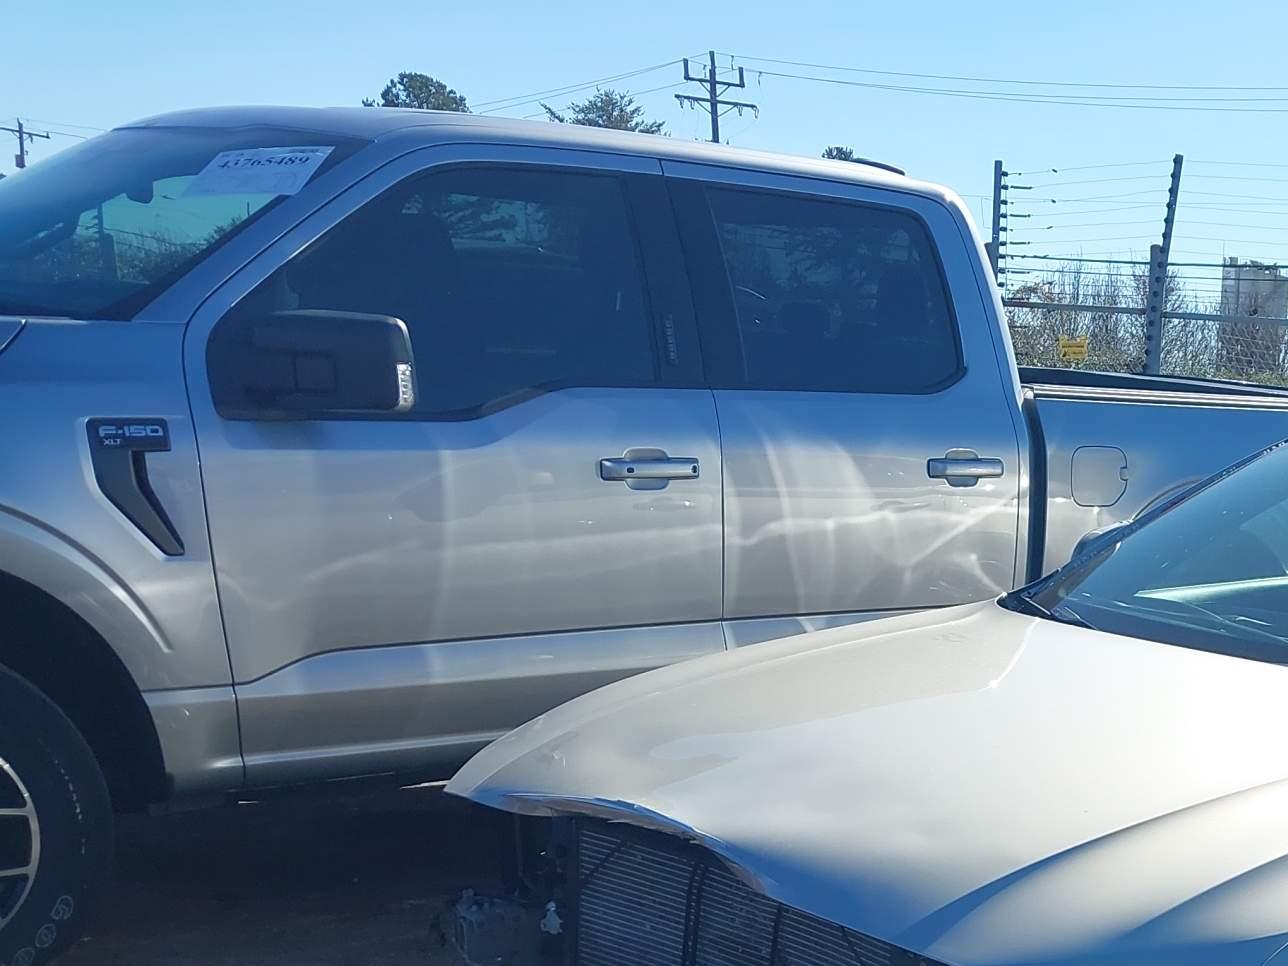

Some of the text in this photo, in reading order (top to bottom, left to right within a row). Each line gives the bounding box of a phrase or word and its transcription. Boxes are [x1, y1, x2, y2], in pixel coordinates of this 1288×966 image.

[217, 156, 311, 169] 43765489
[98, 425, 164, 438] F-150
[103, 438, 121, 446] XLT
